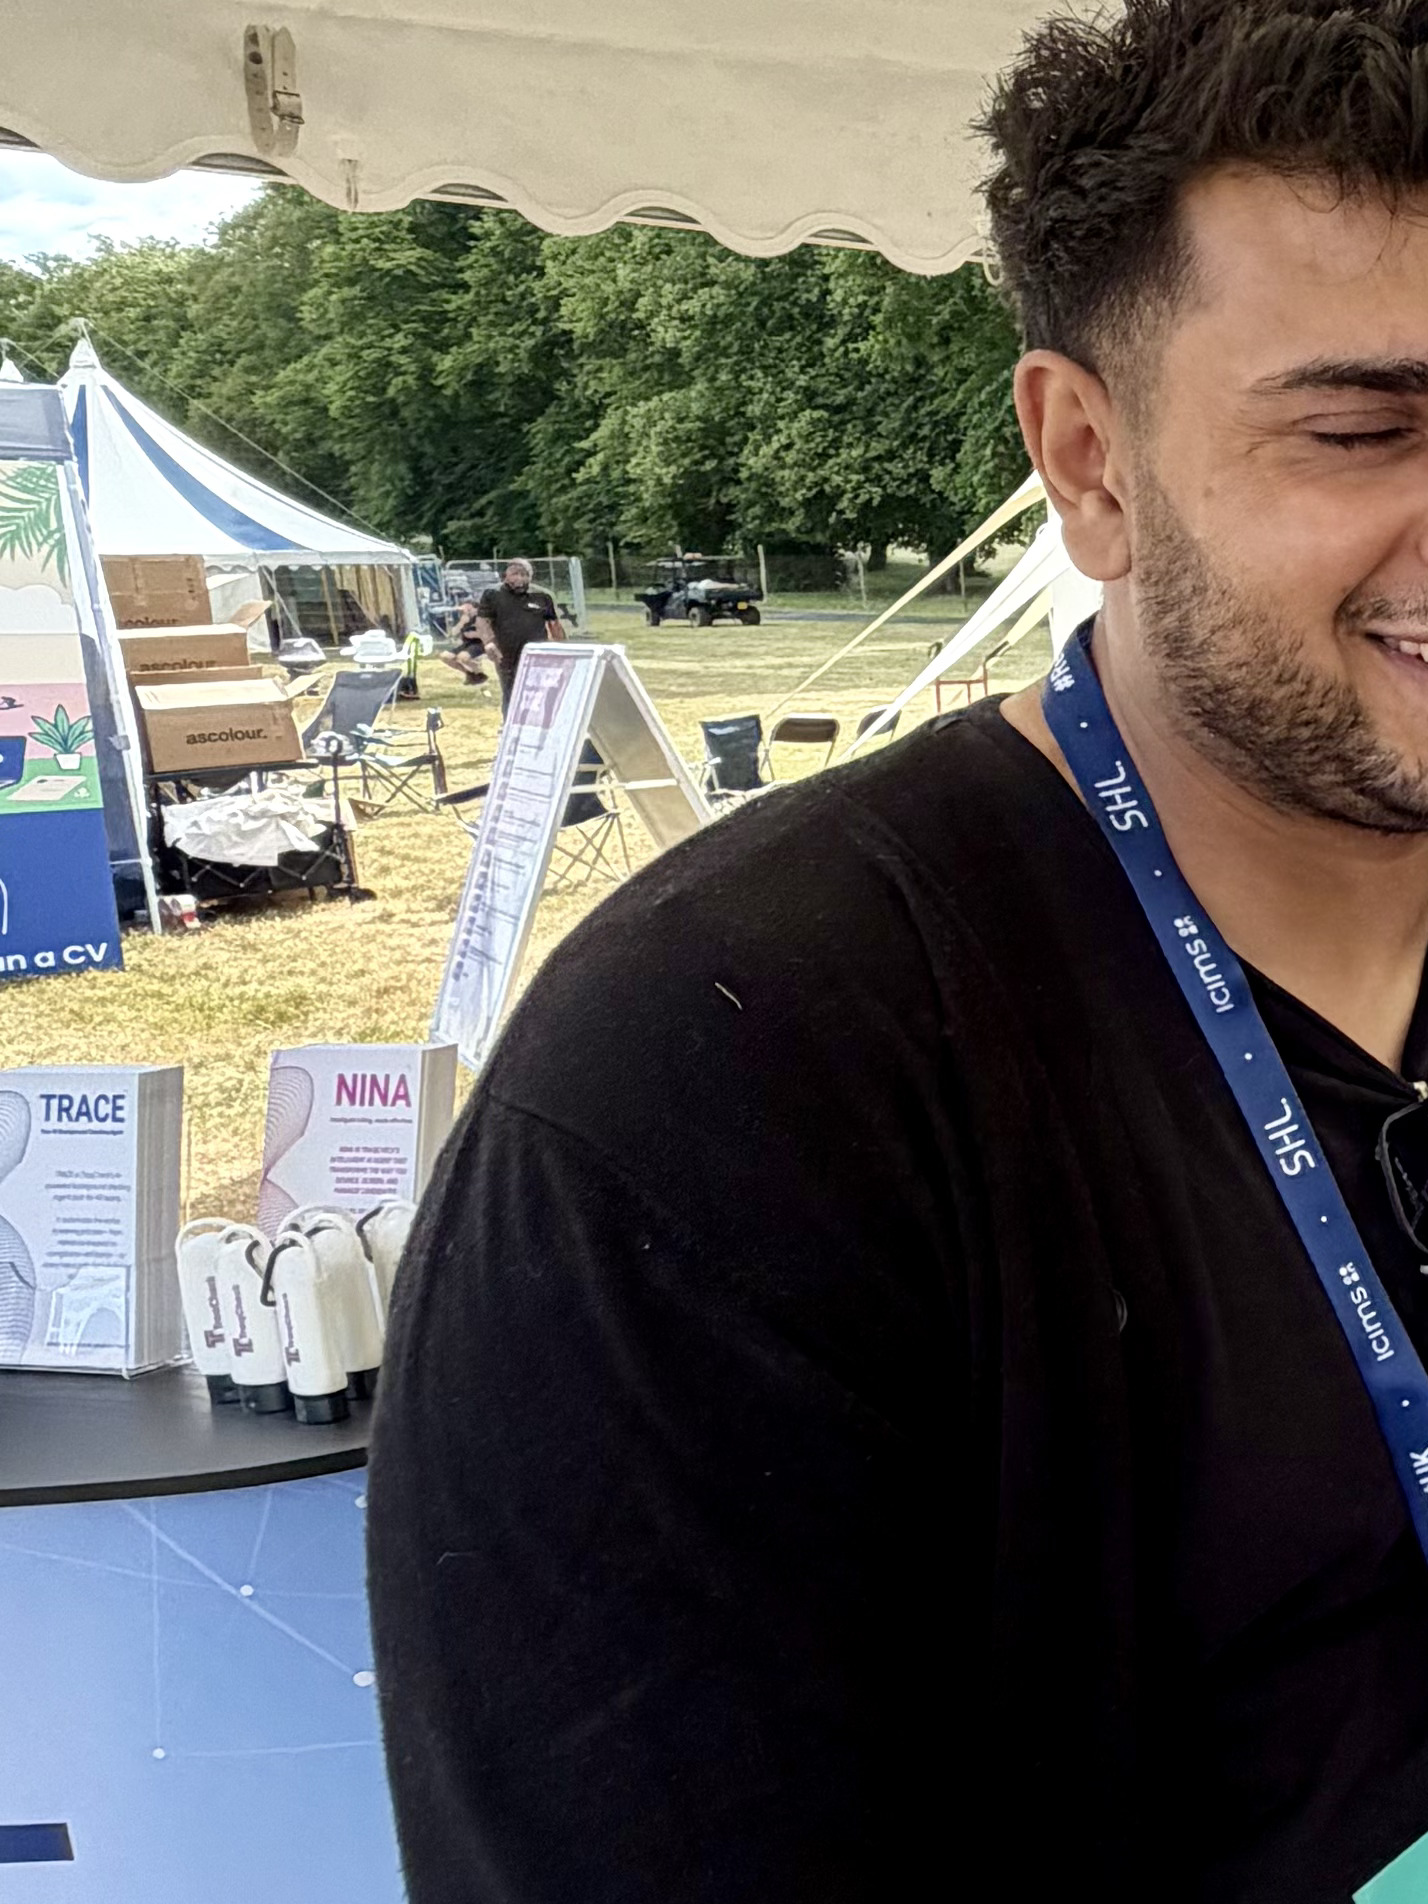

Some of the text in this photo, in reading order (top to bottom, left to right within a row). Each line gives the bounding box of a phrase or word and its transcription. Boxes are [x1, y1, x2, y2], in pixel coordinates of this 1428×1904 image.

[186, 726, 268, 745] ascolour.
[1094, 760, 1149, 831] SHL
[34, 951, 56, 968] a
[62, 942, 108, 965] CV
[335, 1073, 412, 1108] NINA
[40, 1093, 126, 1124] TRACE
[1263, 1096, 1316, 1178] SHL
